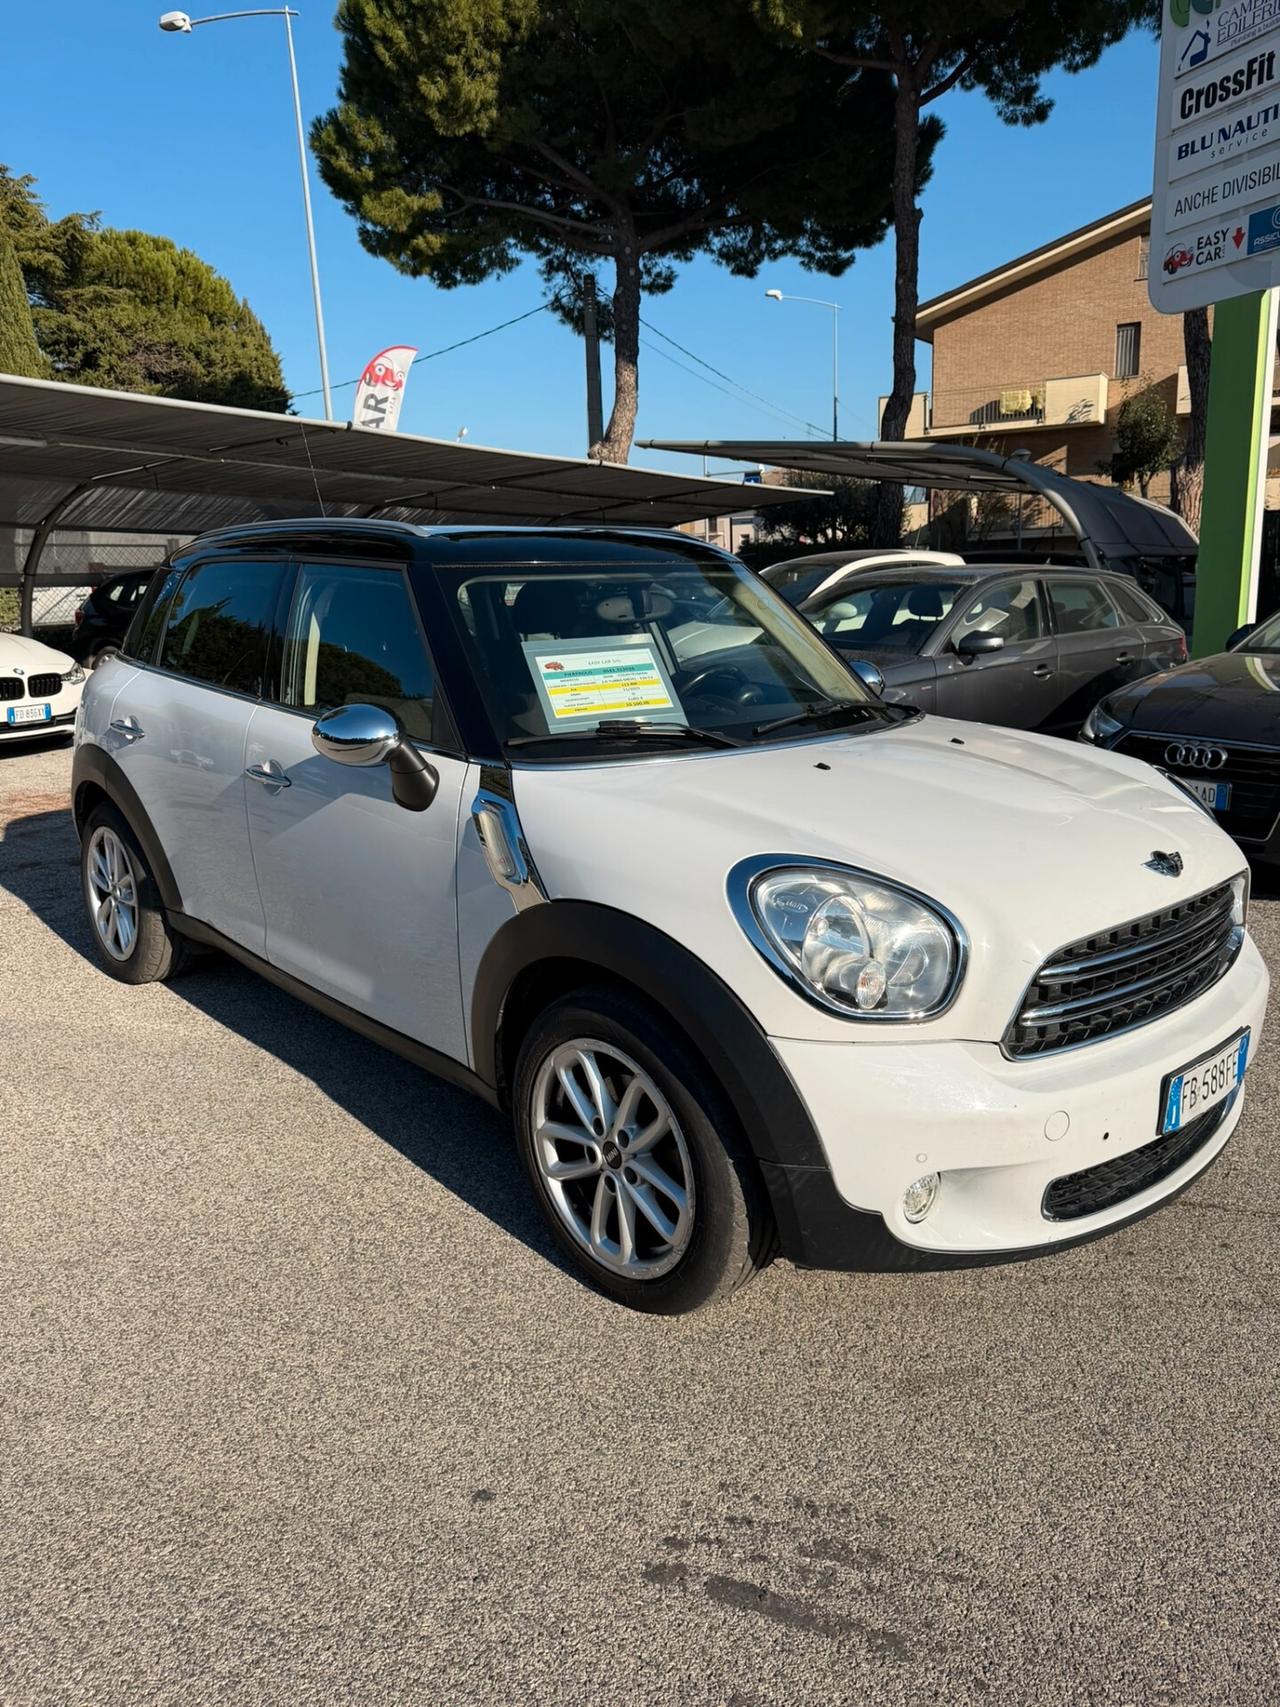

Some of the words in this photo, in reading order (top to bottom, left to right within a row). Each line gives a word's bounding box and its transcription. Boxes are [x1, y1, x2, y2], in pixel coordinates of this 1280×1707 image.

[1217, 0, 1280, 43] EDILFRI
[1180, 50, 1276, 119] CrossFit
[1177, 132, 1214, 160] BLU
[1210, 128, 1268, 158] service
[1174, 185, 1219, 217] ANCHE
[1197, 227, 1231, 250] EASY
[1195, 247, 1221, 265] CAR
[1181, 1076, 1198, 1115] FB
[1201, 1047, 1239, 1101] 588FE
